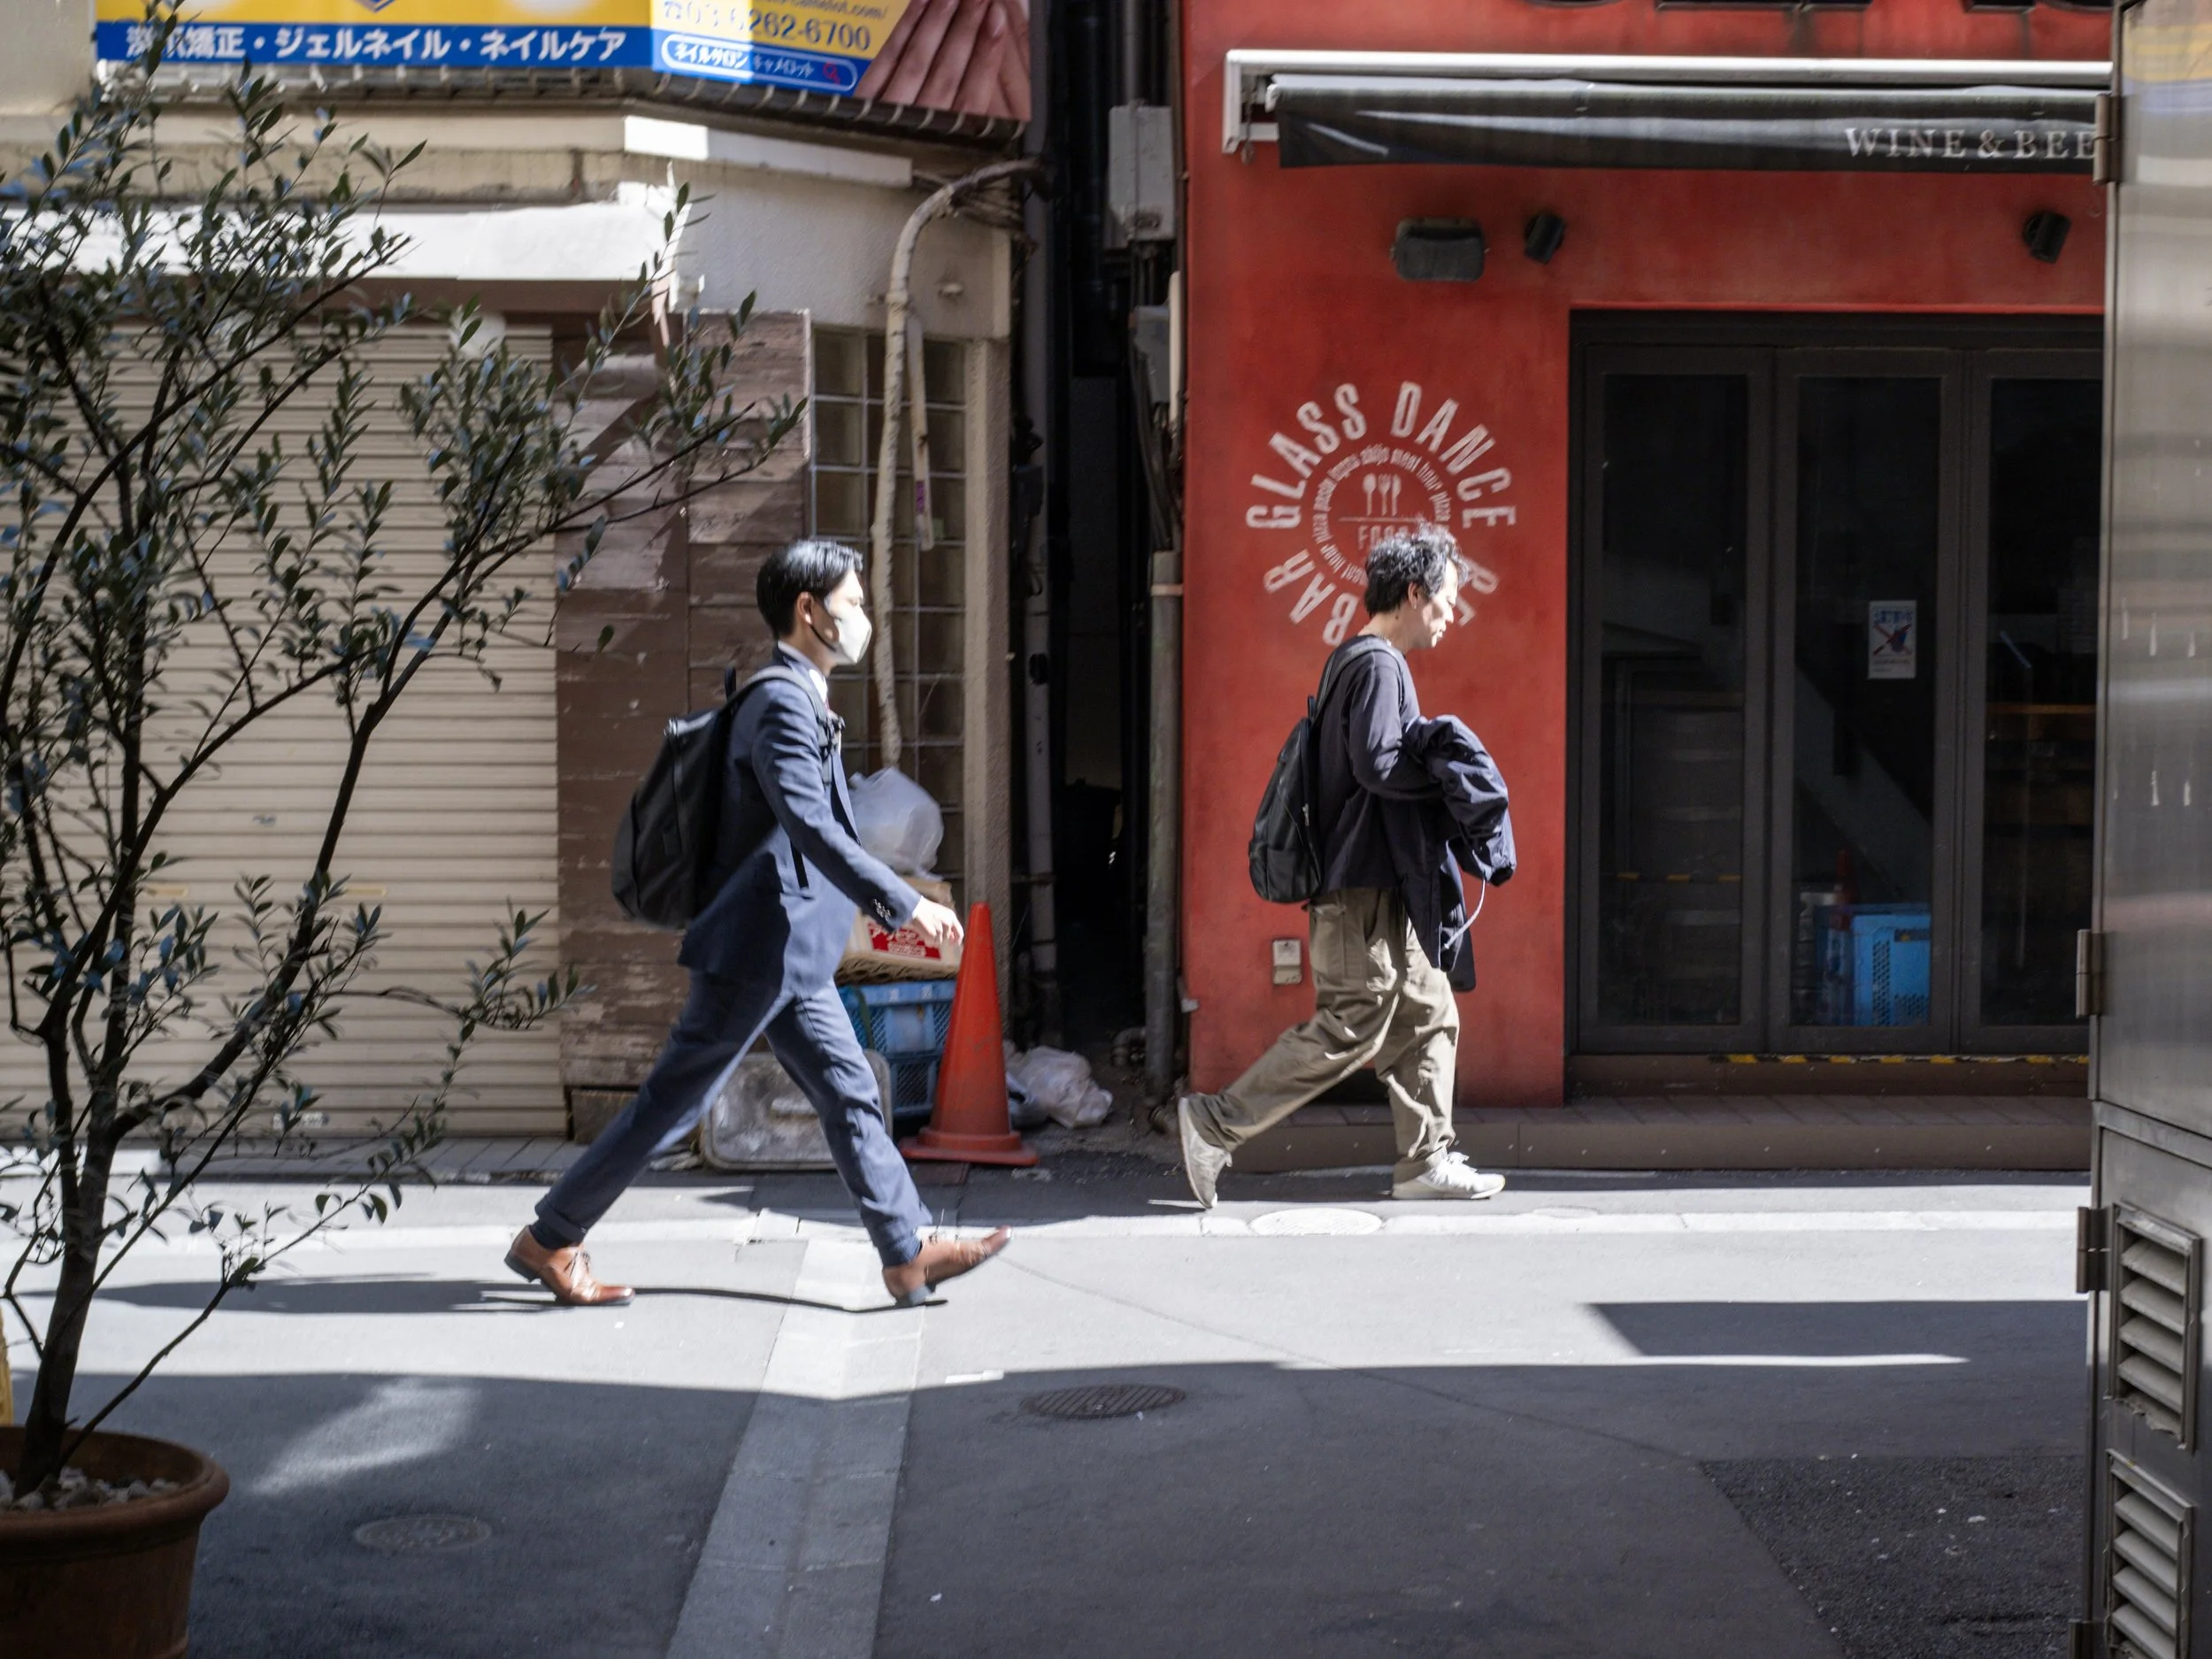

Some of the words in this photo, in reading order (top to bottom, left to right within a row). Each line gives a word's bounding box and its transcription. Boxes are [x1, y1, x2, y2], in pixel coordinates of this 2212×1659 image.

[1246, 383, 1367, 529] GLASS
[1391, 380, 1516, 528] DANCE
[1263, 549, 1360, 647] BAR
